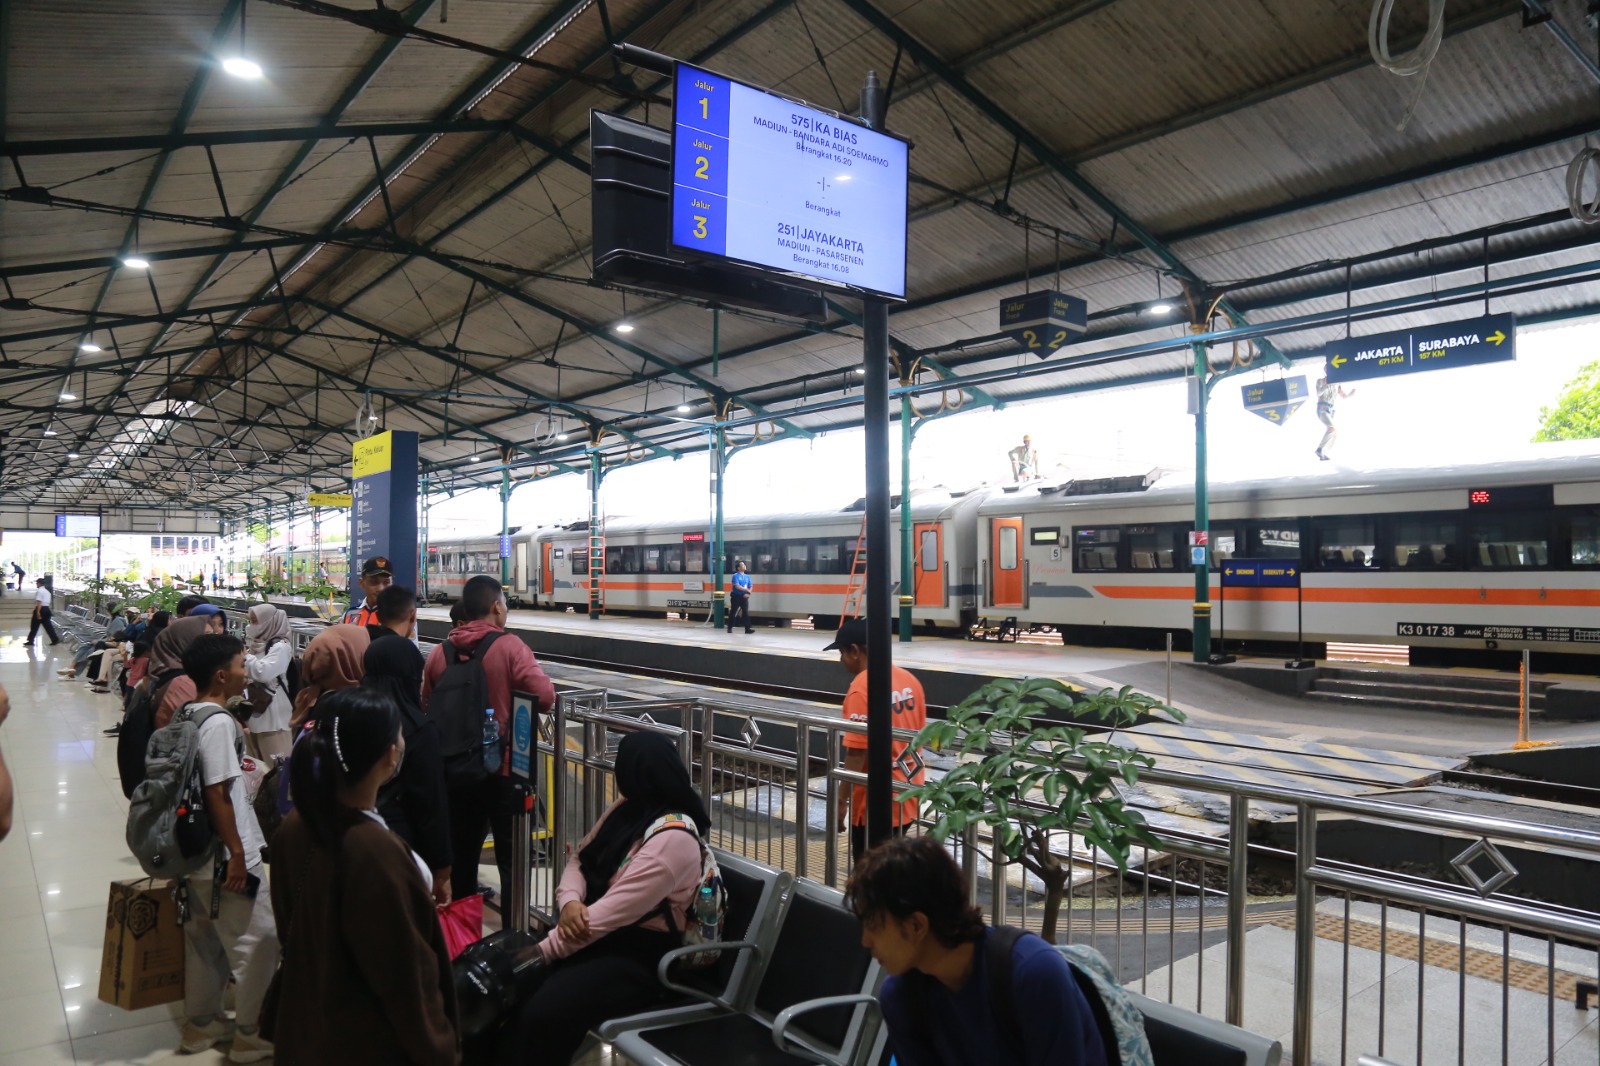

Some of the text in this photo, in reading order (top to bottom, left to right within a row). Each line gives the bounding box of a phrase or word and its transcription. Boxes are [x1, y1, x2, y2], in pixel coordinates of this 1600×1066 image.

[694, 79, 715, 92] Jalur
[699, 97, 708, 119] 1
[692, 138, 713, 151] Jalur
[753, 116, 788, 135] MADIUN
[793, 129, 831, 149] BANDARA
[831, 142, 845, 153] ADI
[846, 146, 889, 168] SOEMARMO
[833, 127, 858, 145] BIAS
[796, 141, 852, 167] Berangkat 16.20
[694, 155, 709, 180] 2
[691, 198, 711, 210] Jalur
[805, 200, 841, 218] Berangkat
[692, 215, 708, 239] 3
[777, 237, 811, 253] MADIUN
[816, 246, 864, 266] PASARSENEN
[793, 253, 850, 274] Berangkat 16.08
[1005, 302, 1025, 313] Jalur
[1053, 298, 1069, 310] Jalur
[1022, 330, 1042, 349] 2
[1048, 330, 1067, 349] 2
[1354, 334, 1480, 362] JAKARTA SURABAYA
[1378, 349, 1446, 366] 671 KM 157 KM
[1264, 409, 1281, 421] 3
[1053, 549, 1058, 557] 5
[1399, 624, 1414, 635] K3
[1416, 625, 1423, 635] 0
[1426, 625, 1439, 636] 17
[1441, 626, 1455, 636] 38
